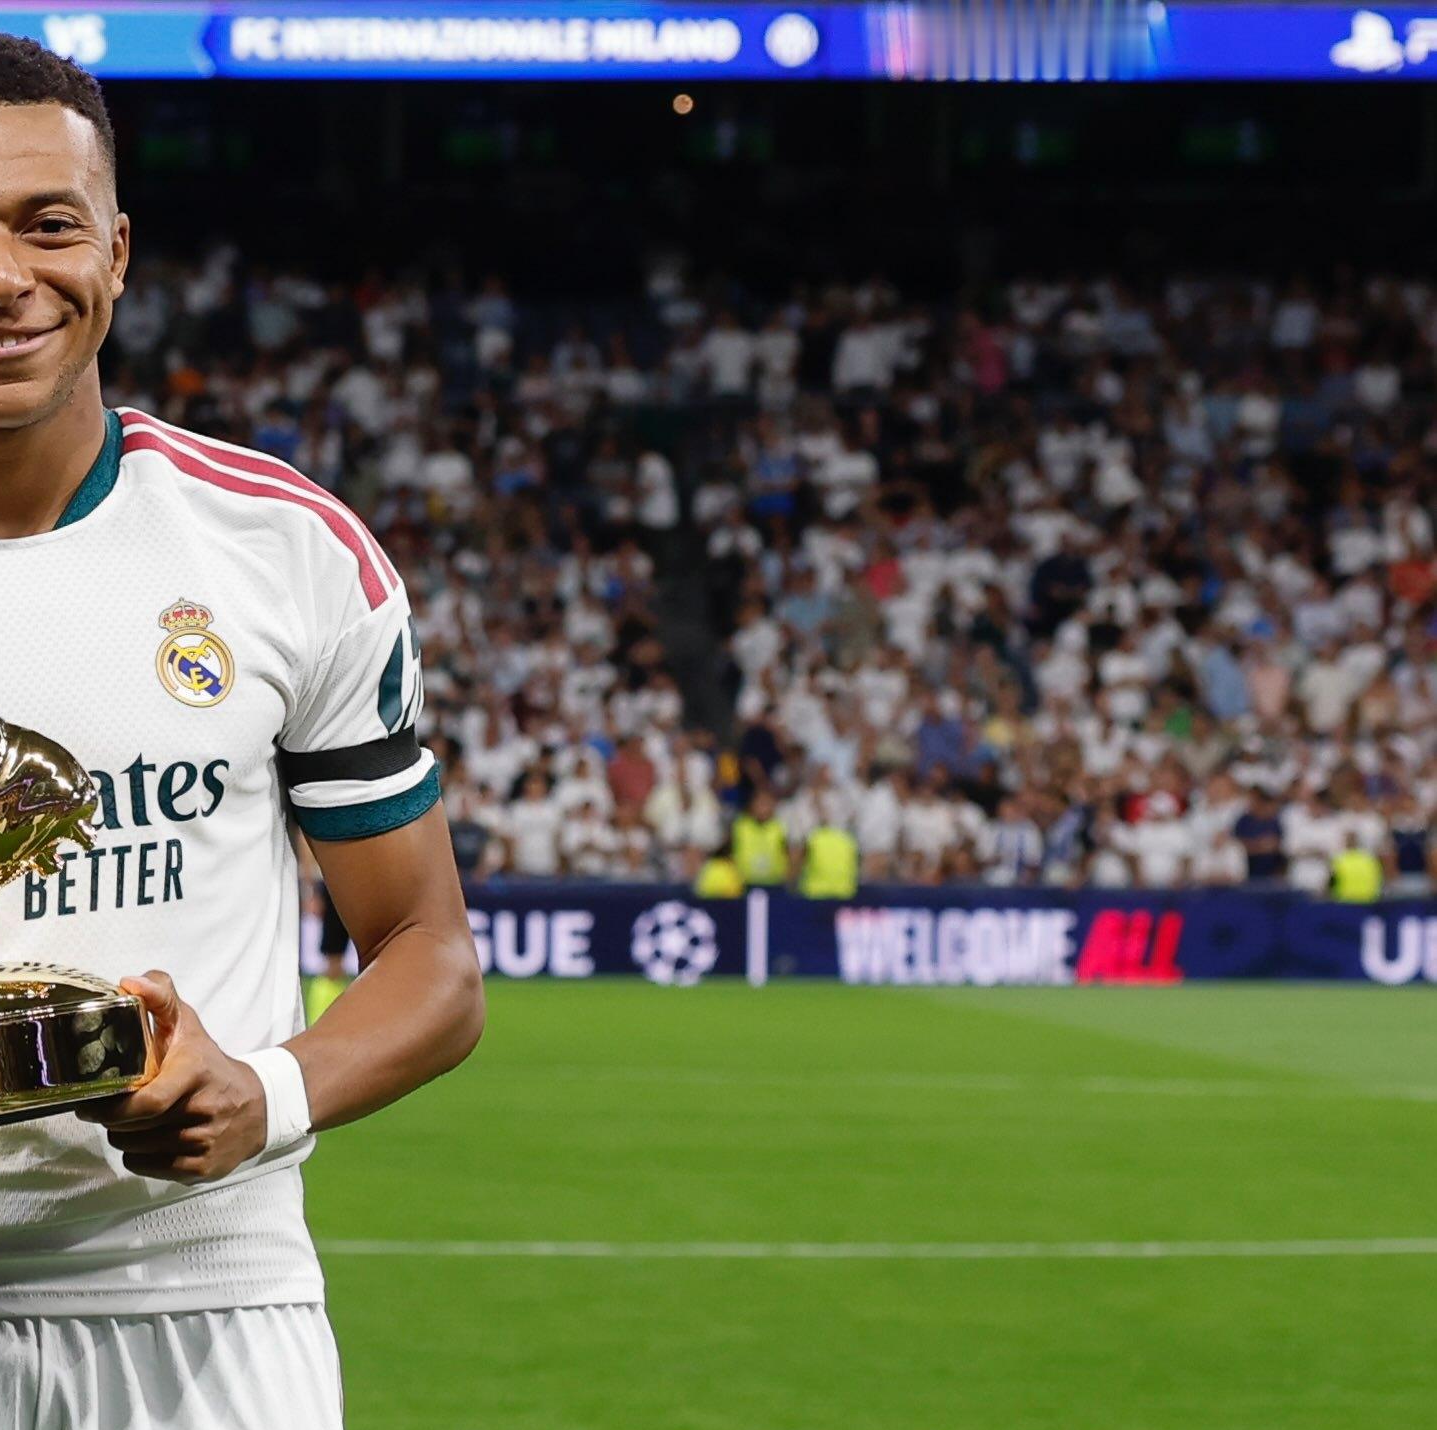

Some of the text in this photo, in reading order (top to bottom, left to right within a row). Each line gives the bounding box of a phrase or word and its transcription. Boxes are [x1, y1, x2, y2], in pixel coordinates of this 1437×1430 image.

[43, 14, 107, 64] VS
[24, 838, 184, 921] BETTER
[835, 906, 1184, 986] WELCOME ALL
